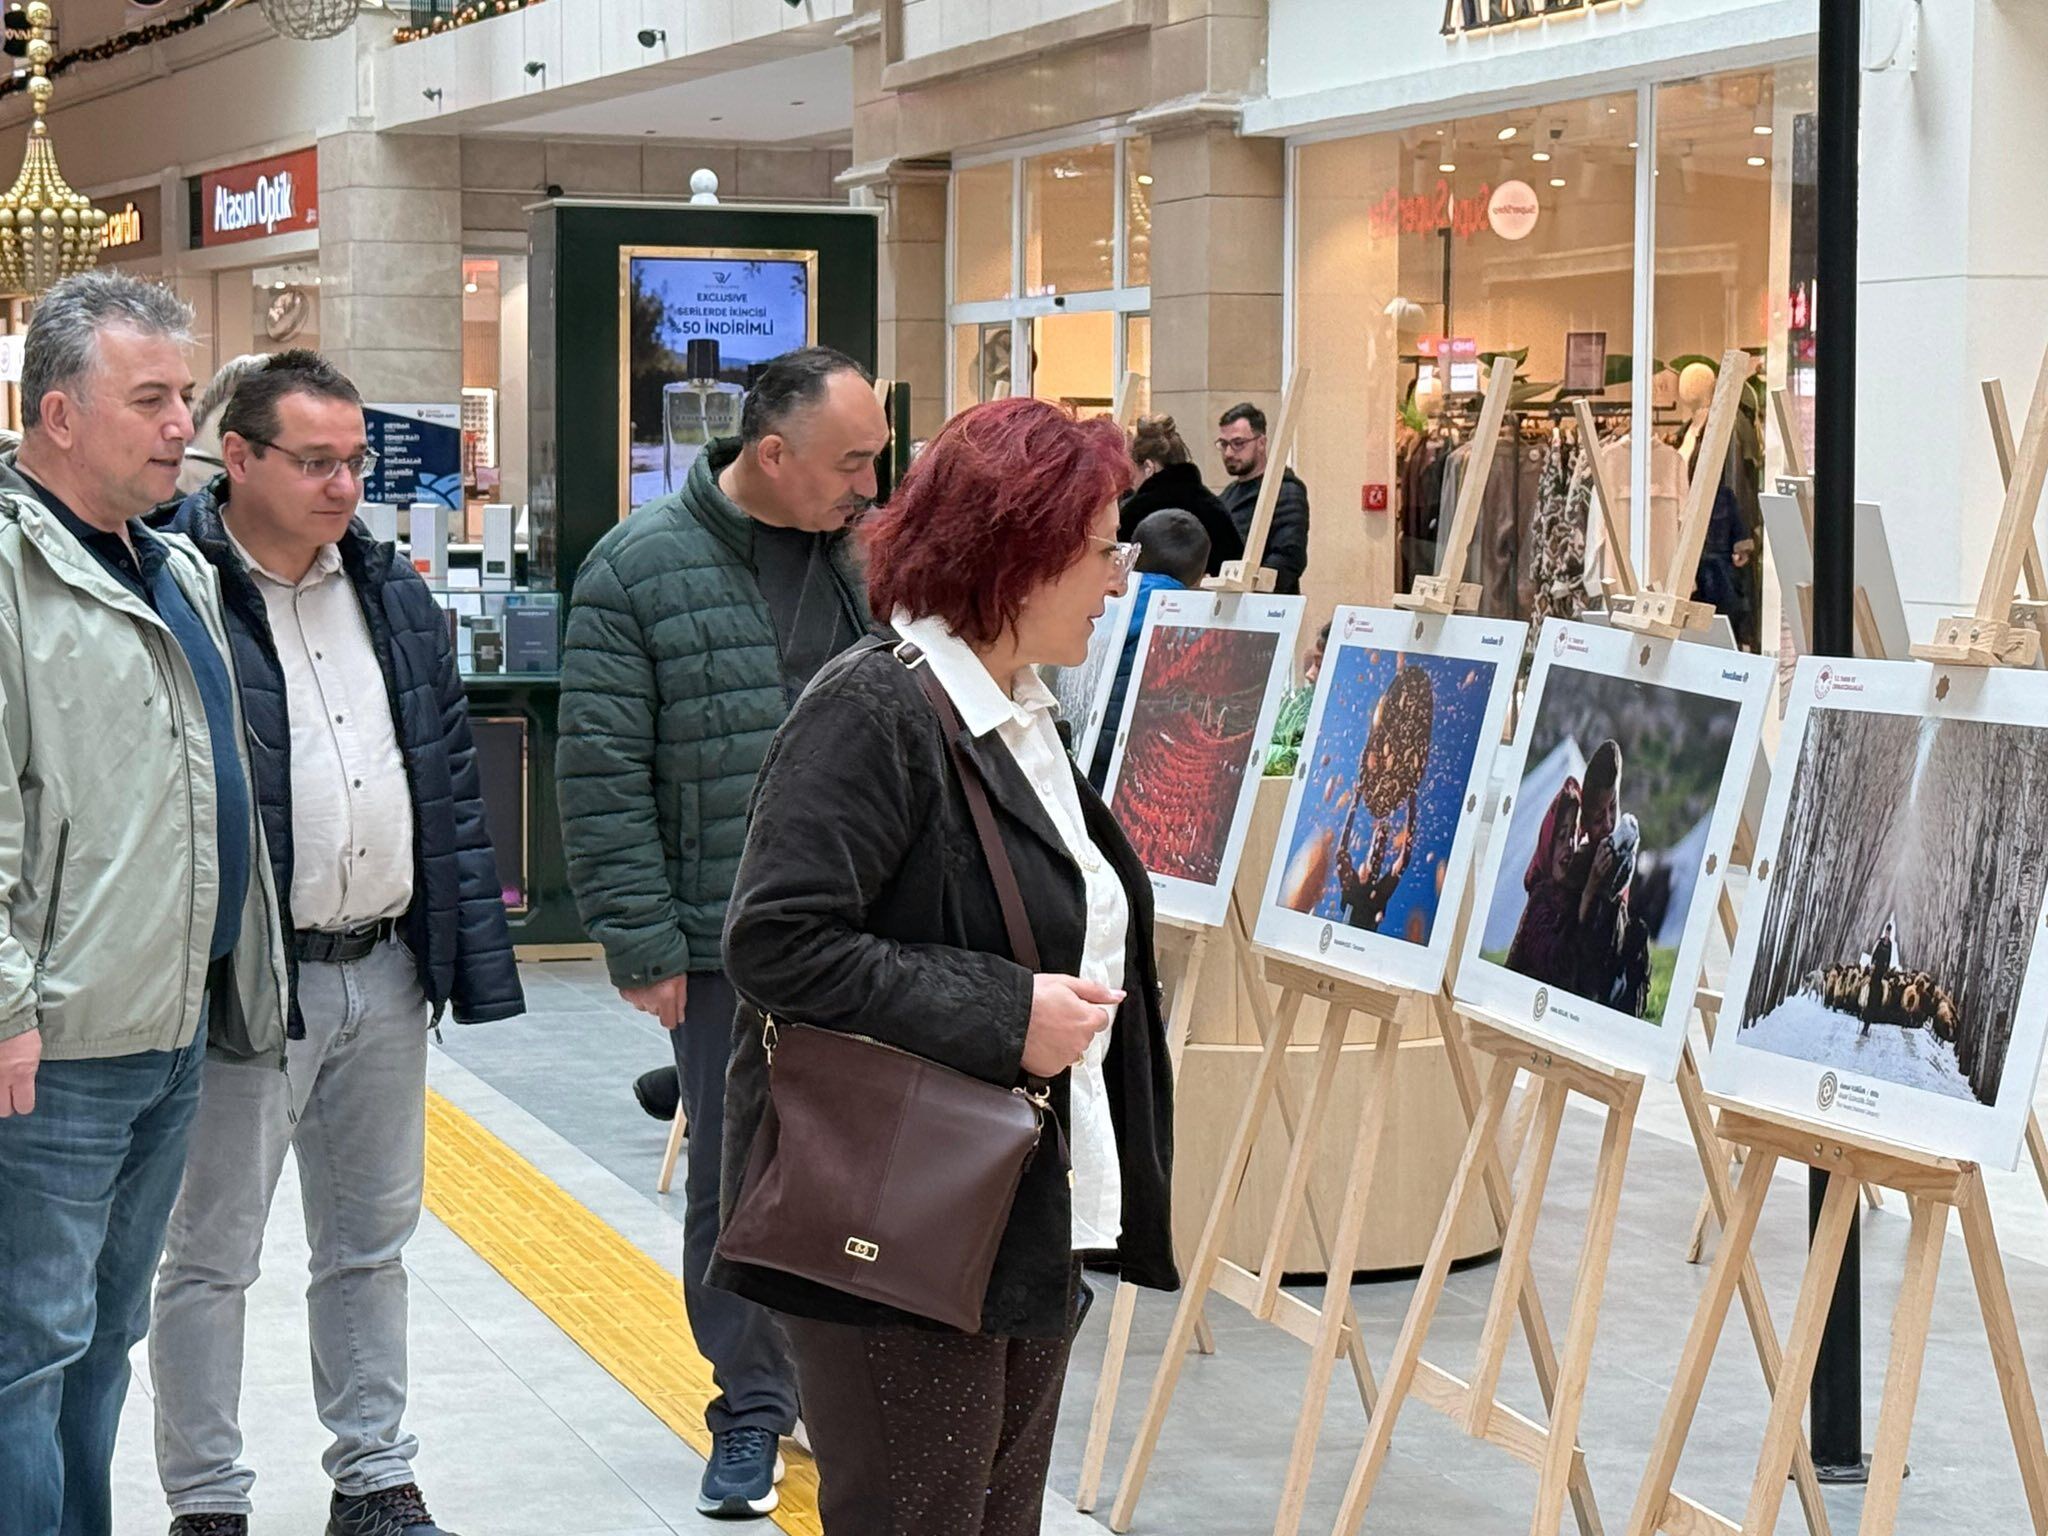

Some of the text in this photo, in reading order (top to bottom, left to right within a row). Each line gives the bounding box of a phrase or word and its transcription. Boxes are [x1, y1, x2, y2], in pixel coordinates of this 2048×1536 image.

[214, 171, 292, 234] Atasun Optik
[696, 292, 748, 303] EXCLUSIVE
[678, 306, 767, 317] SERİLERDE İKİNCİSİ
[673, 319, 774, 335] %50 İNDİRİMLİ
